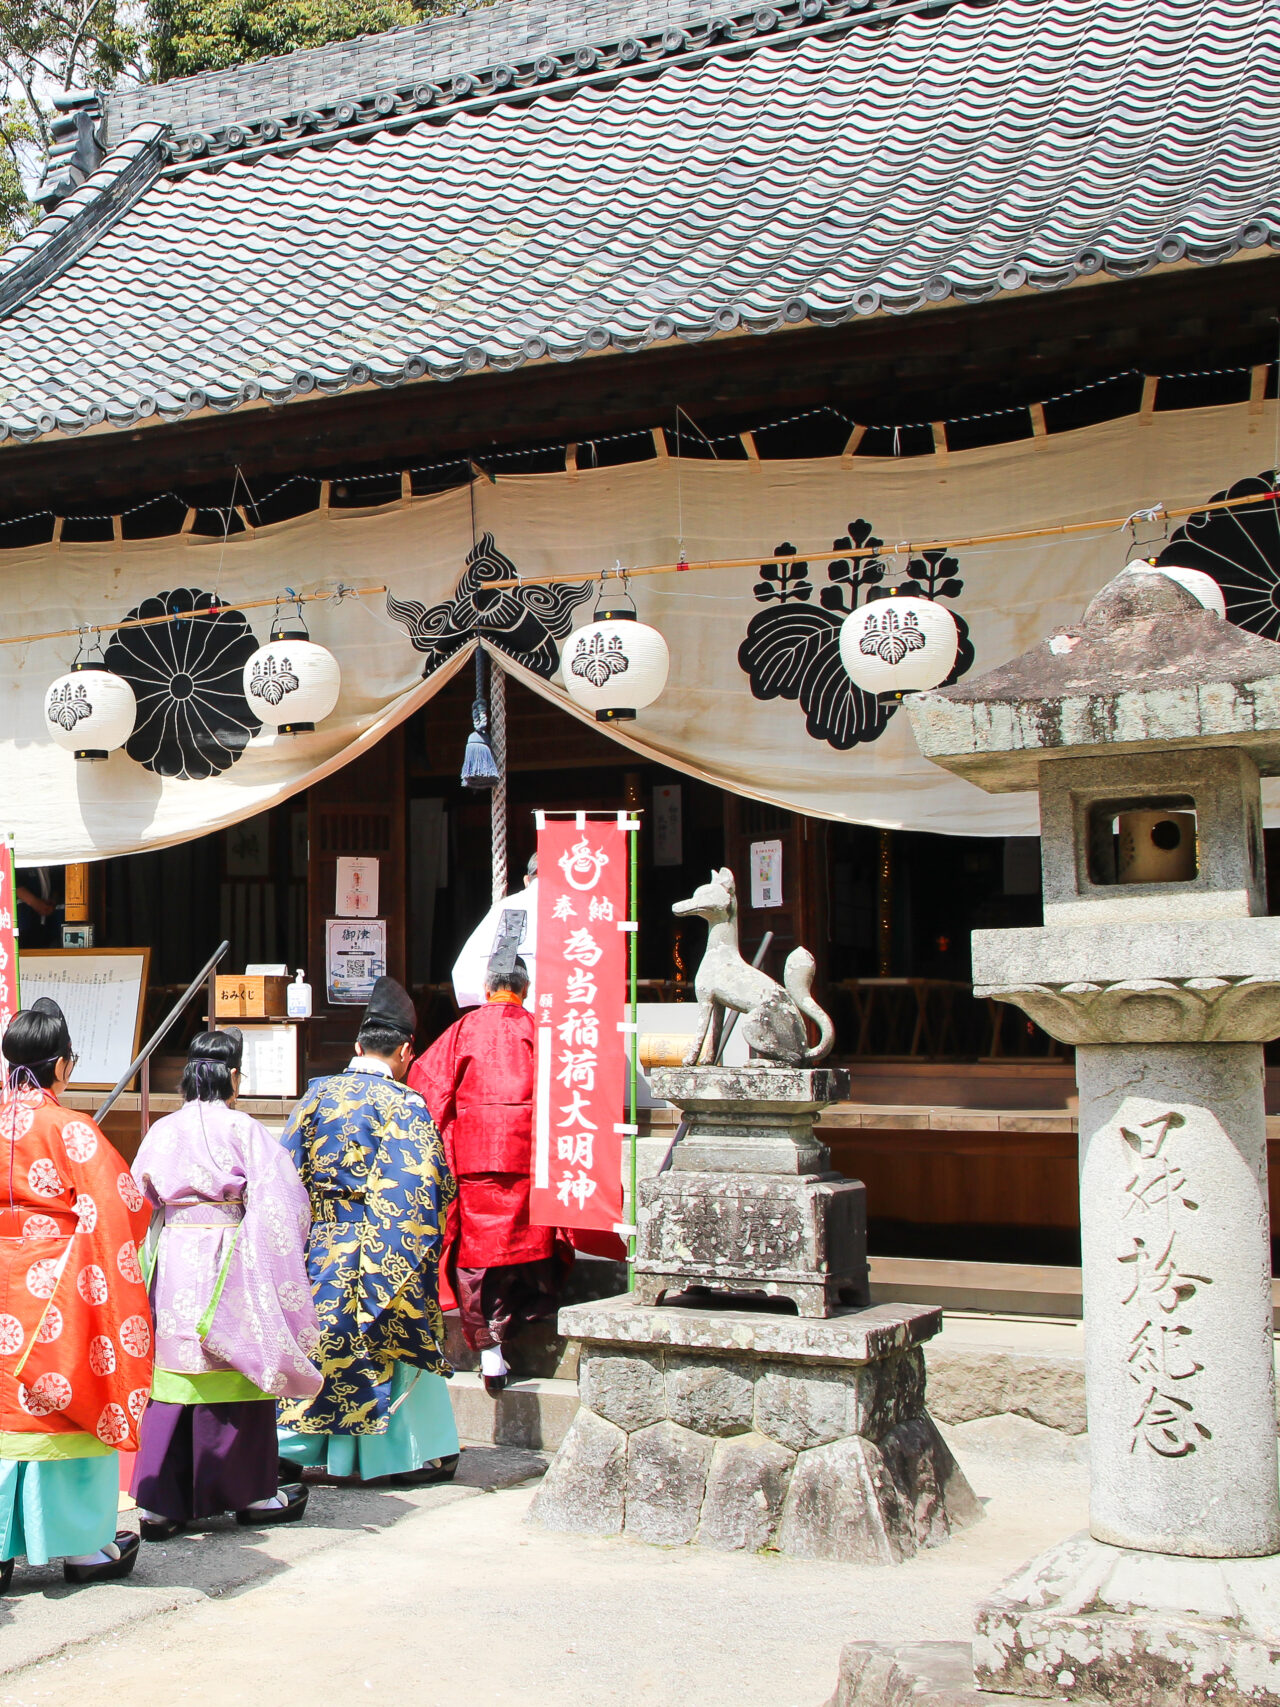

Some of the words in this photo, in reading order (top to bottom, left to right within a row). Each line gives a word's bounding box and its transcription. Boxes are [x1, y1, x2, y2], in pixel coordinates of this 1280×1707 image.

[551, 894, 614, 923] 奉納
[220, 990, 256, 1001] おみくじ
[538, 993, 554, 1024] 願主
[555, 927, 604, 1211] 為当稲荷大明神
